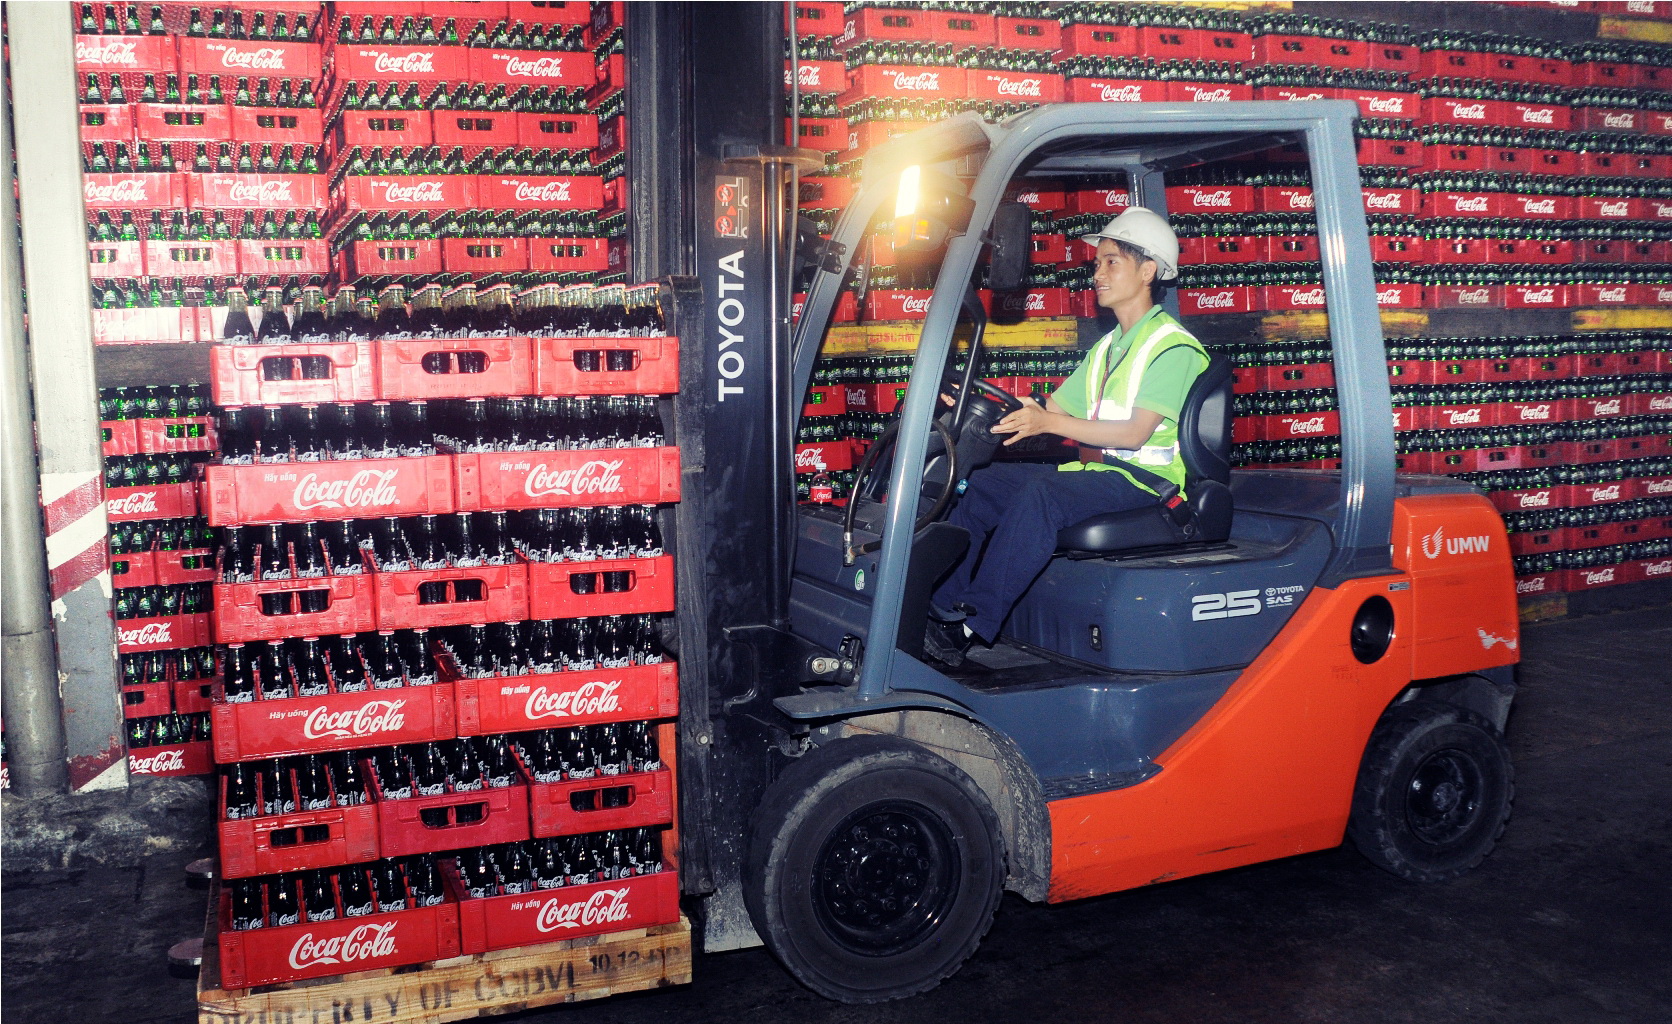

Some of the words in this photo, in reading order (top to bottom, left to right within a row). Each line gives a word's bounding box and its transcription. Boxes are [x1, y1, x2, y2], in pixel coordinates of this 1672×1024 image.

[221, 47, 286, 69] Coca-Cola
[375, 52, 434, 73] Coca-Cola
[506, 57, 562, 77] Coca-Cola
[893, 72, 940, 91] Coca-Cola
[997, 78, 1041, 96] Coca-Cola
[1369, 97, 1403, 113] Coca-Cola
[1453, 103, 1486, 119] Coca-Cola
[1523, 107, 1554, 124] Coca-Cola
[1604, 112, 1635, 128] Coca-Cola
[230, 180, 292, 201] Coca-Cola
[385, 181, 444, 202] Coca-Cola
[515, 181, 571, 202] Coca-Cola
[1193, 190, 1232, 207] Coca-Cola
[1366, 192, 1401, 209] Coca-Cola
[1455, 196, 1488, 212] Coca-Cola
[1525, 198, 1555, 214] Coca-Cola
[1601, 201, 1628, 217] Coca-Cola
[1197, 291, 1234, 309] Coca-Cola
[1459, 288, 1489, 304] Coca-Cola
[1524, 288, 1554, 304] Coca-Cola
[1599, 287, 1627, 302] Coca-Cola
[717, 249, 745, 403] TOYOTA
[1450, 408, 1481, 425] Coca-Cola
[1521, 404, 1550, 420] Coca-Cola
[1594, 399, 1621, 416] Coca-Cola
[1290, 416, 1325, 434] Coca-Cola
[524, 459, 624, 498] Coca-Cola
[293, 467, 399, 511] Coca-Cola
[1593, 485, 1620, 502] Coca-Cola
[1520, 491, 1550, 508] Coca-Cola
[1446, 535, 1490, 555] UMW
[1517, 576, 1545, 594] Coca-Cola
[1586, 567, 1615, 585] Coca-Cola
[1276, 584, 1305, 595] TOYOTA
[1191, 589, 1262, 622] 25
[1266, 594, 1294, 605] SAS
[524, 679, 622, 720] Coca-Cola
[303, 699, 406, 740] Coca-Cola
[536, 886, 631, 933] Coca-Cola
[288, 919, 398, 970] Coca-Cola
